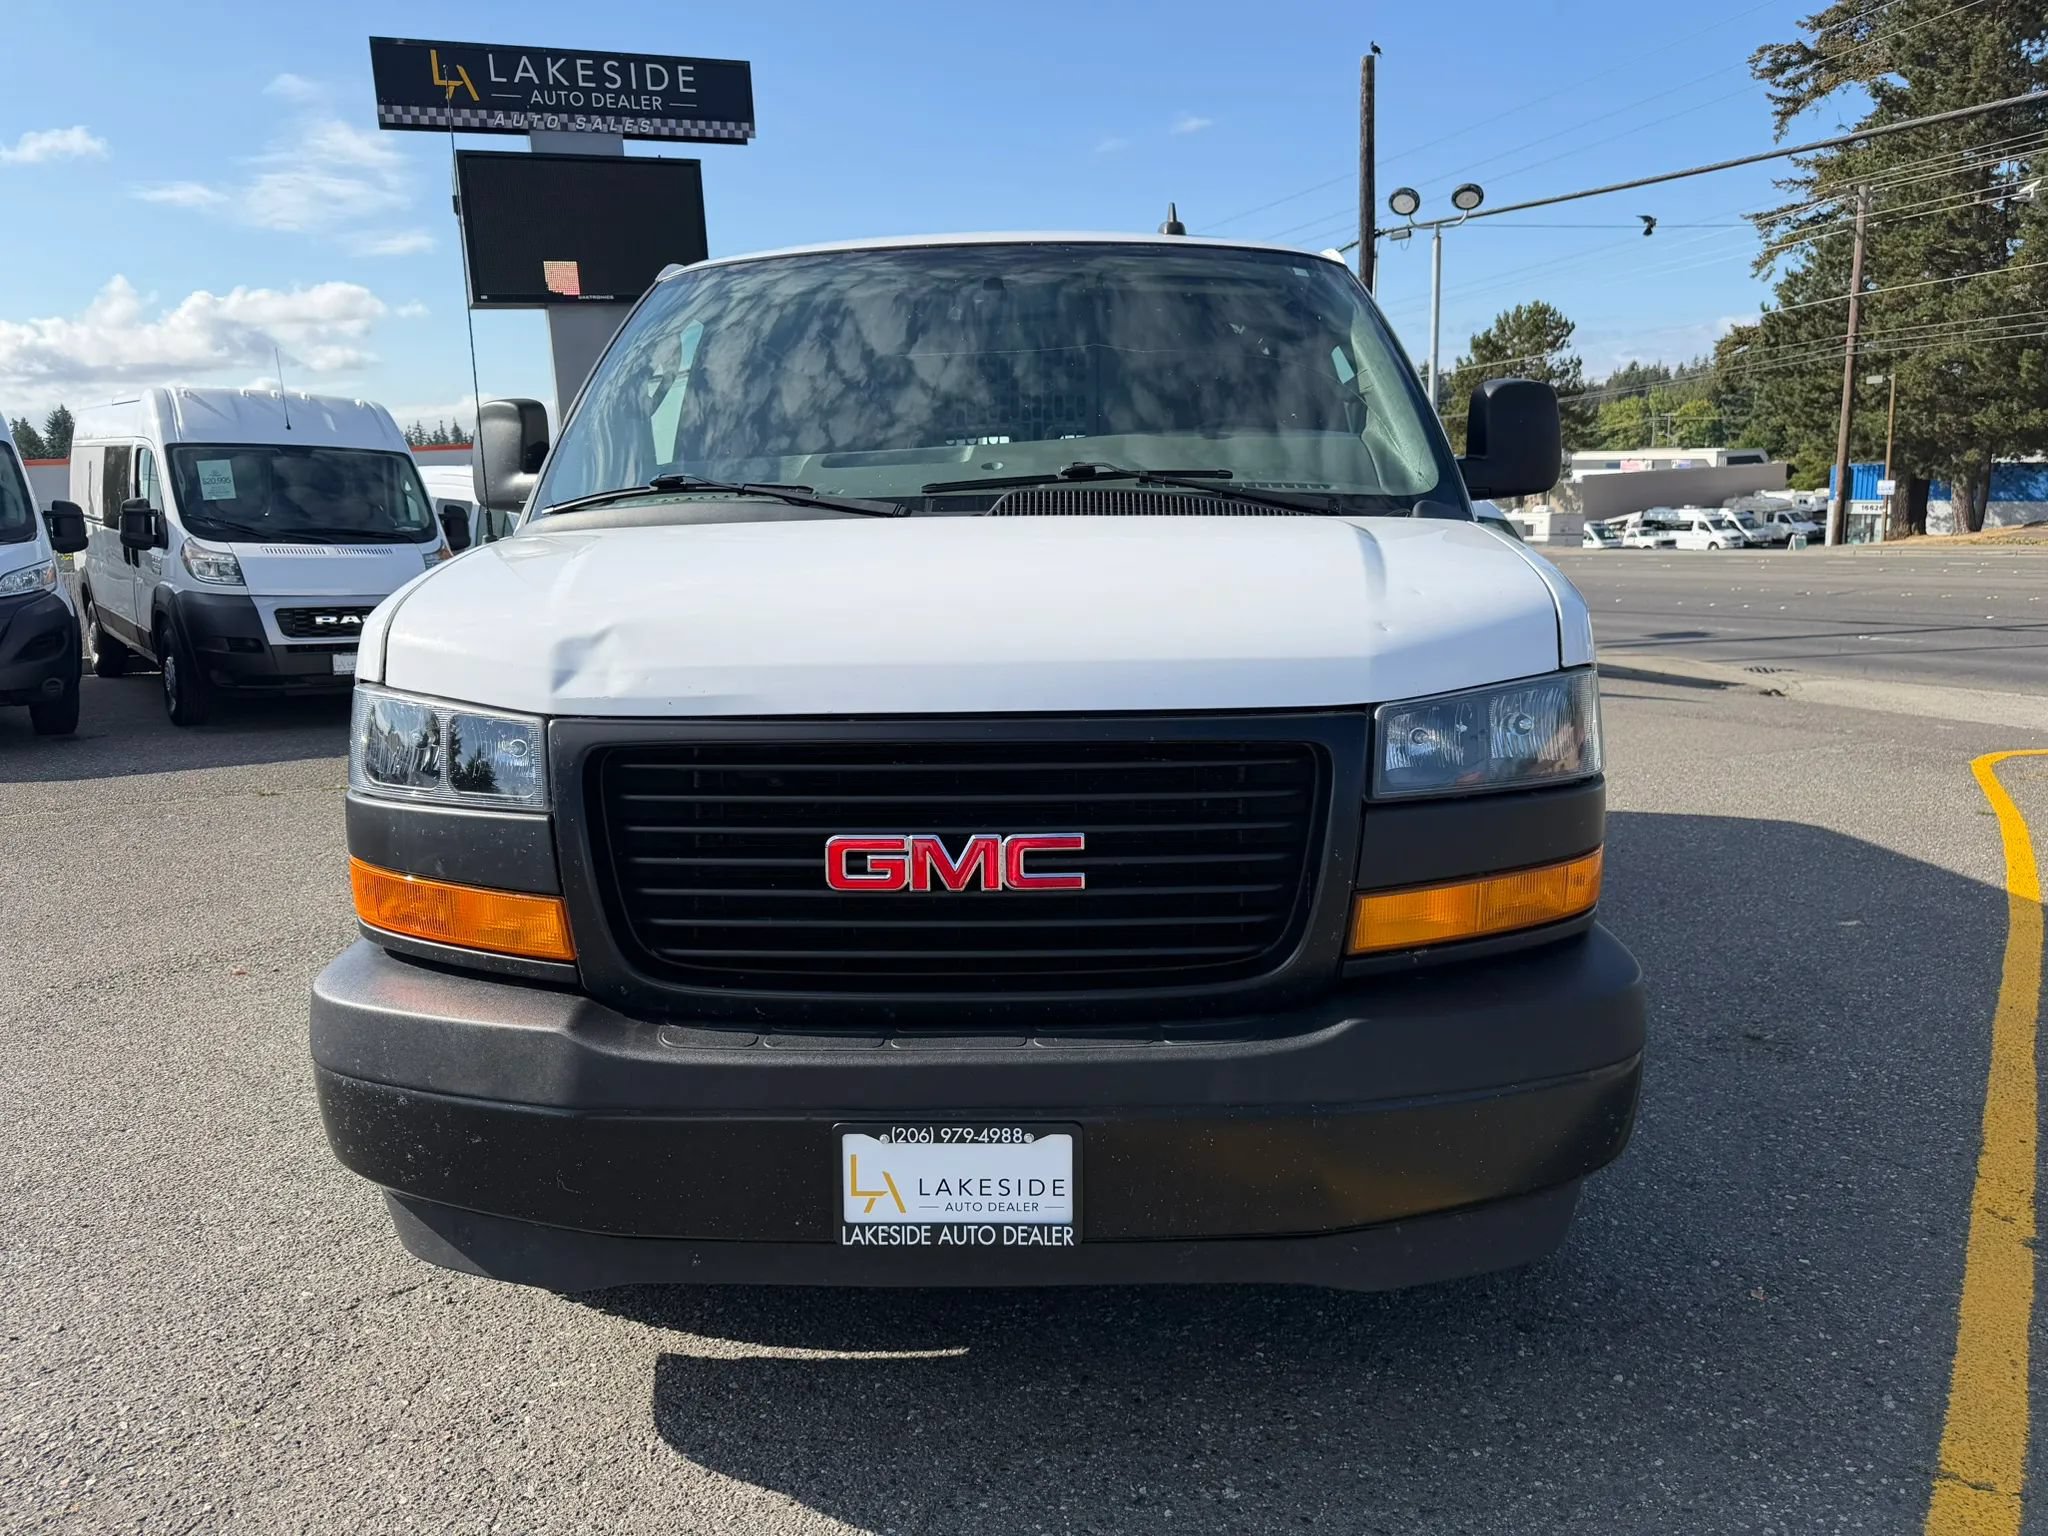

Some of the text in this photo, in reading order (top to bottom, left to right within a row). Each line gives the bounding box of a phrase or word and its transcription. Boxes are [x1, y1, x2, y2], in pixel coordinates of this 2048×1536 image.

[487, 53, 698, 94] LAKESIDE
[530, 89, 663, 111] AUTO DEALER
[493, 113, 652, 133] AUTO SALES
[825, 833, 1085, 892] GMC
[891, 1126, 1023, 1145] (206) 979-4988
[918, 1178, 1065, 1197] LAKESIDE
[944, 1202, 1039, 1212] AUTO DEALER
[842, 1225, 1075, 1246] LAKESIDE AUTO DEALER
